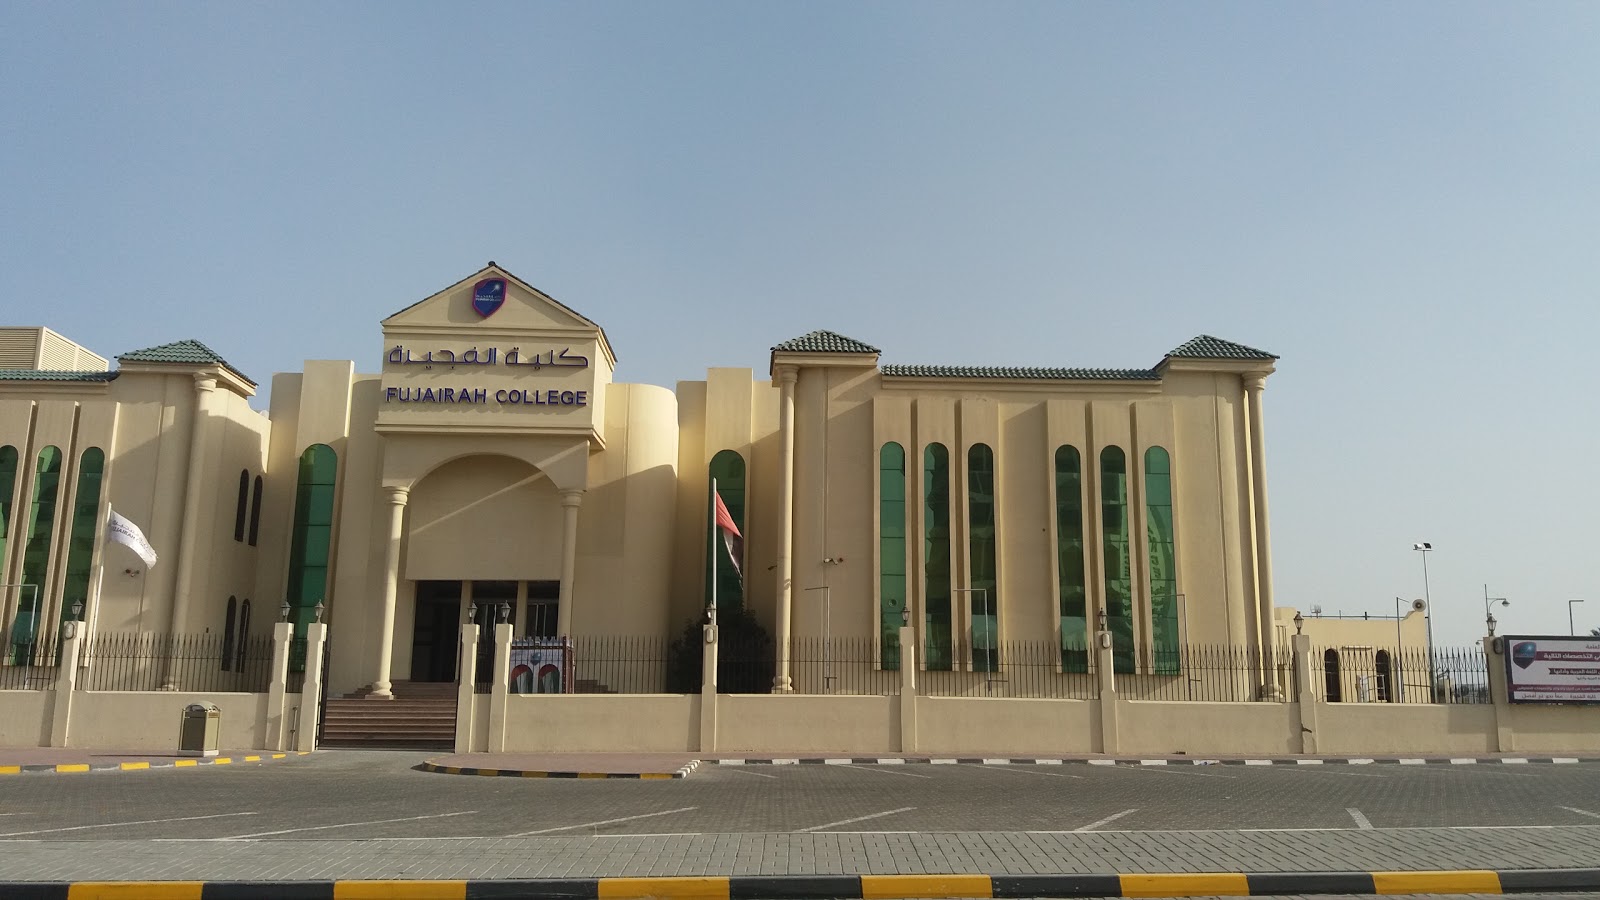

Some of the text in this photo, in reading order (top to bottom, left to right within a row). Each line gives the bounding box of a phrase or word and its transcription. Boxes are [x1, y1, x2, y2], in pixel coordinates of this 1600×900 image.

[389, 345, 589, 370] كلية الفجيرة
[386, 387, 588, 406] FUJAIRAH COLLEGE
